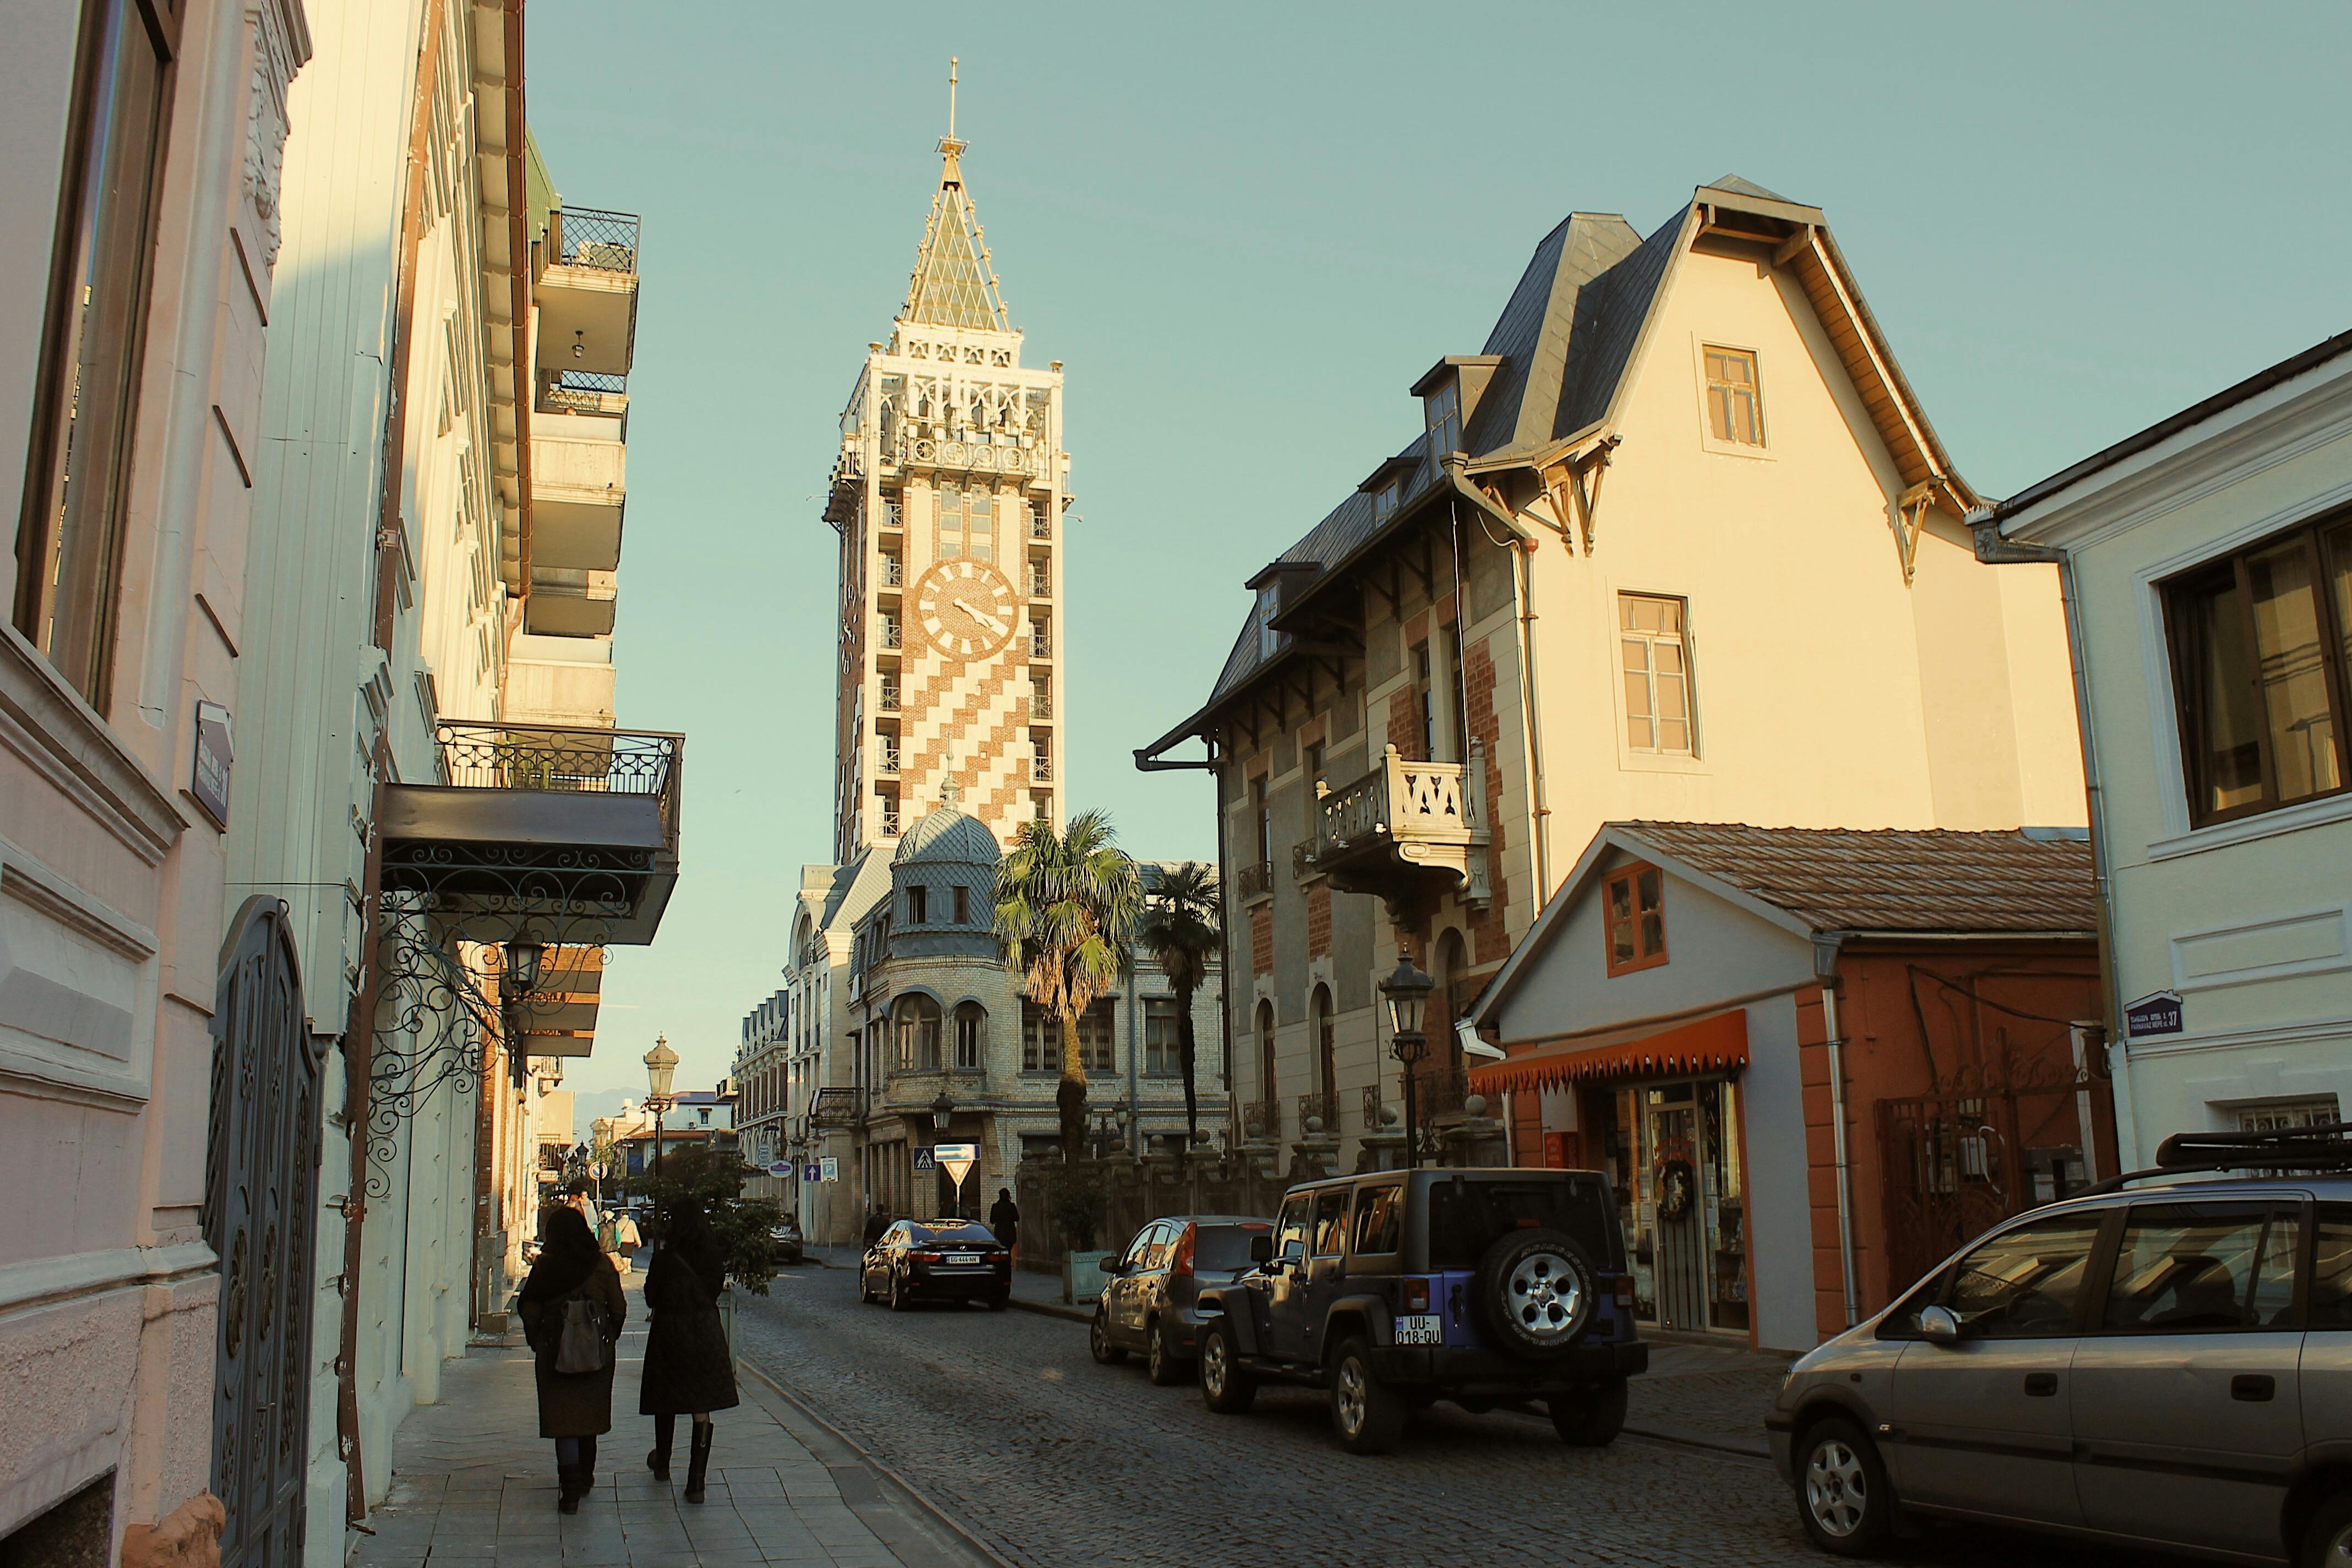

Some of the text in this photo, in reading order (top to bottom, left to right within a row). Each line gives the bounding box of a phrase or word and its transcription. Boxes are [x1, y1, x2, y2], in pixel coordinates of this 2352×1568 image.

[2168, 1010, 2177, 1026] 37
[1409, 1316, 1430, 1330] UU-
[1397, 1330, 1440, 1344] 018-QU
